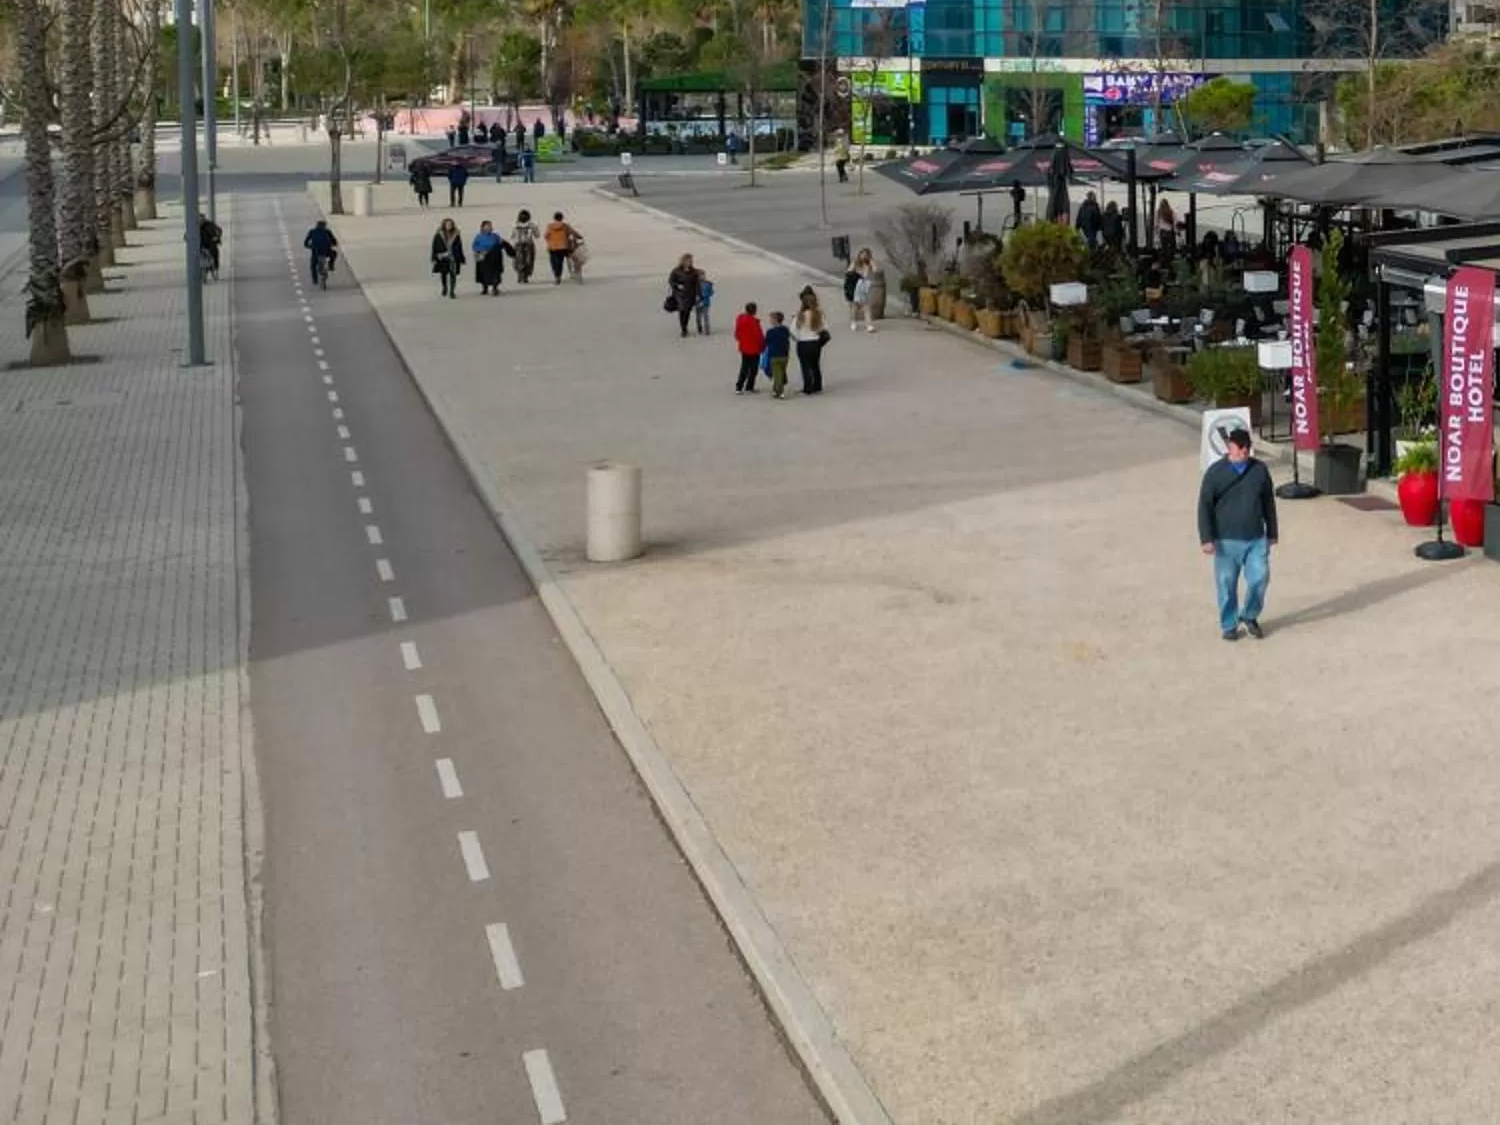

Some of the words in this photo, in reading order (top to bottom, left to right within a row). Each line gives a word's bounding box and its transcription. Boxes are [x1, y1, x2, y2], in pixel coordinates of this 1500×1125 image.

[1449, 285, 1469, 407] BOUTIQUE
[1293, 375, 1309, 435] NOAR
[1467, 350, 1484, 423] HOTEL
[1446, 414, 1462, 482] NOAR
